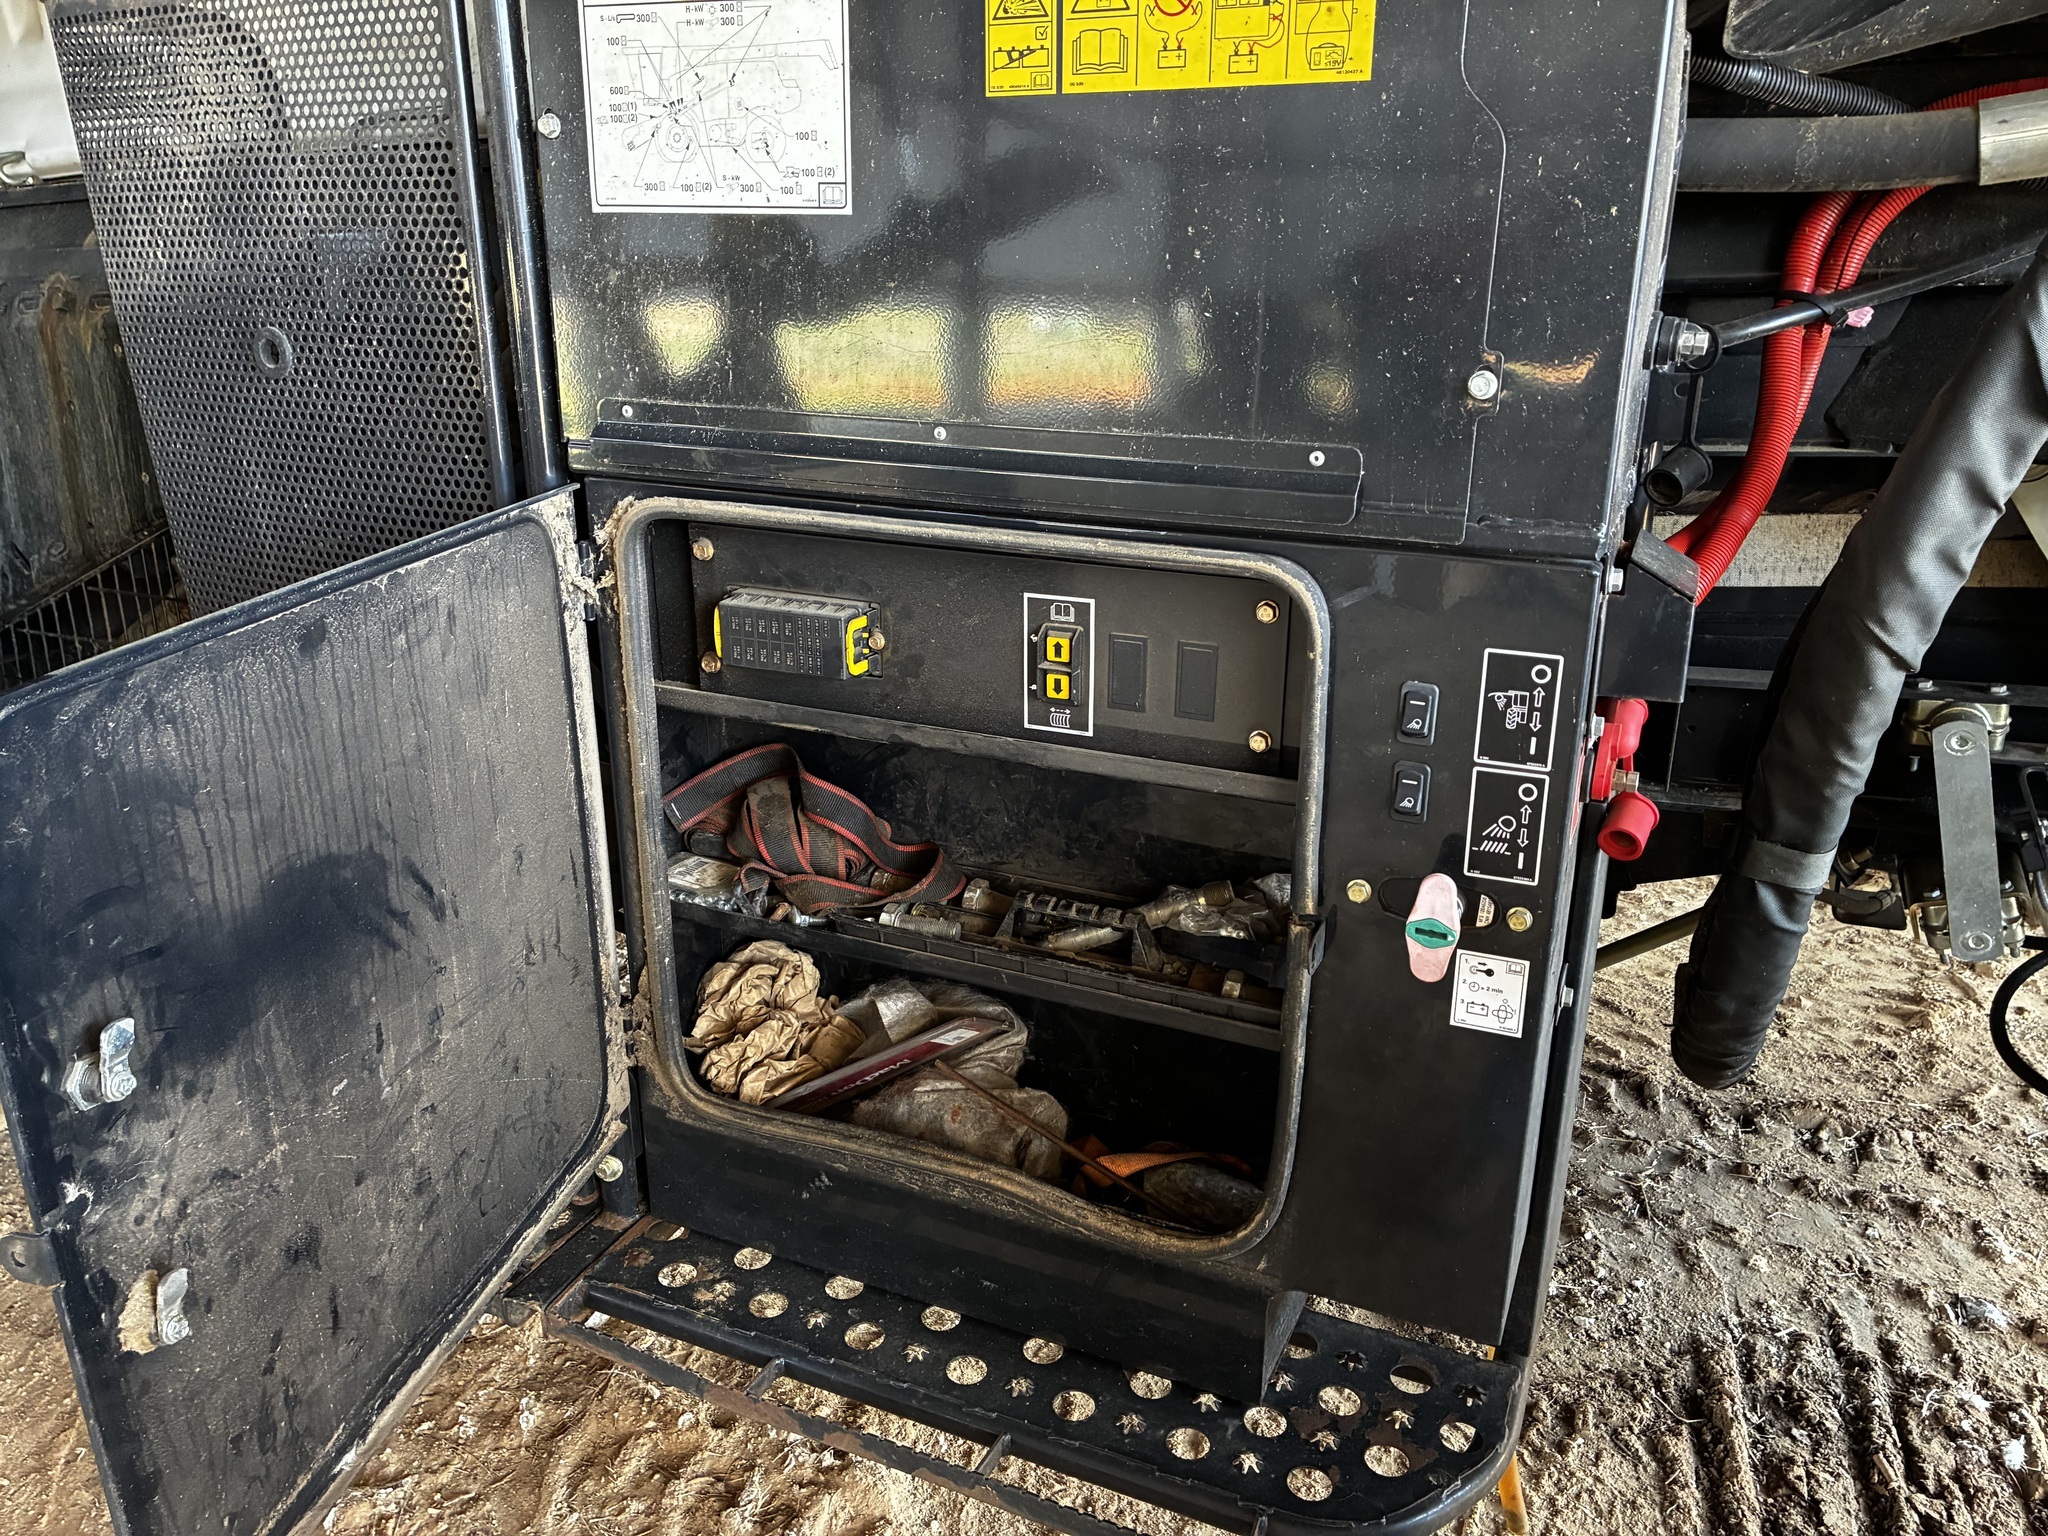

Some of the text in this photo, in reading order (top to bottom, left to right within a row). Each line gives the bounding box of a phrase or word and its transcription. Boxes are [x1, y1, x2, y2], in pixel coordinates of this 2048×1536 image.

[720, 3, 735, 12] 300
[636, 14, 650, 23] 300
[720, 17, 735, 26] 300
[606, 37, 620, 46] 100
[609, 86, 624, 95] 600
[609, 103, 622, 112] 100
[610, 113, 638, 124] 100 (2)
[795, 131, 810, 140] 100
[801, 167, 835, 178] 100 (2)
[644, 182, 658, 191] 300
[680, 182, 712, 192] 100 (2)
[740, 184, 754, 192] 300
[780, 186, 794, 195] 100
